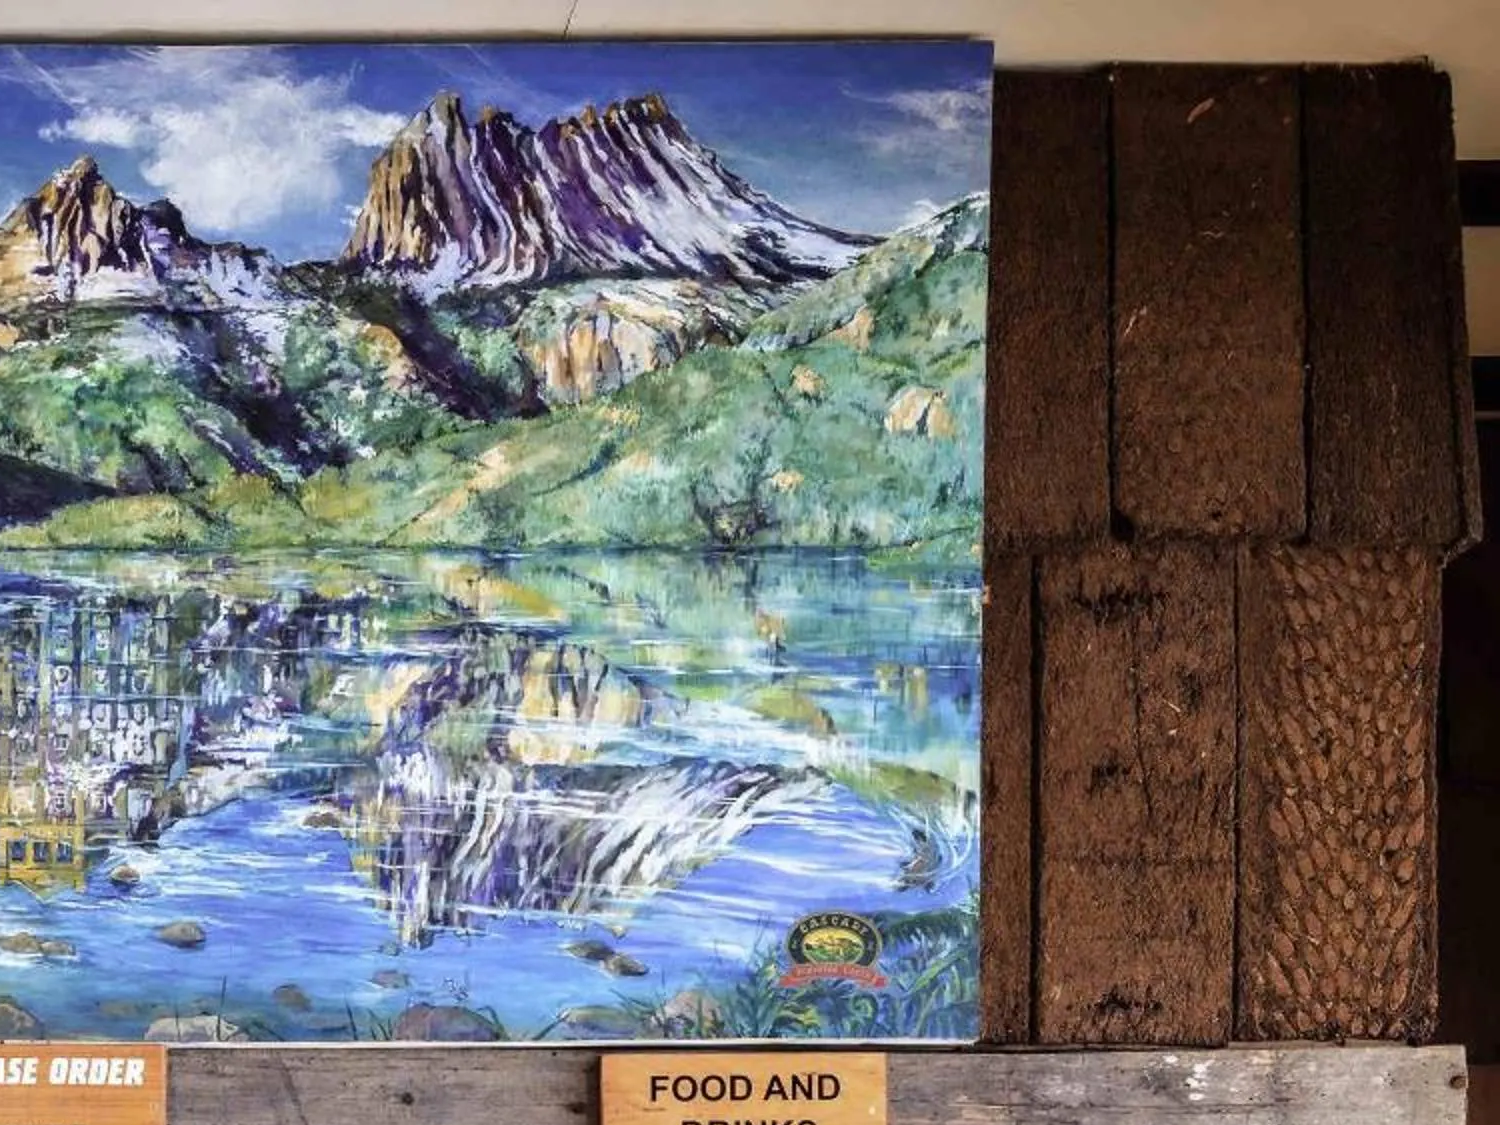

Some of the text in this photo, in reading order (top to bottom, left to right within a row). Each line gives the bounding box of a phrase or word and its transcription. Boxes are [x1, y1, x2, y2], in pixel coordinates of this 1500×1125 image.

[48, 1057, 145, 1086] ORDER
[650, 1074, 841, 1102] FOOD AND
